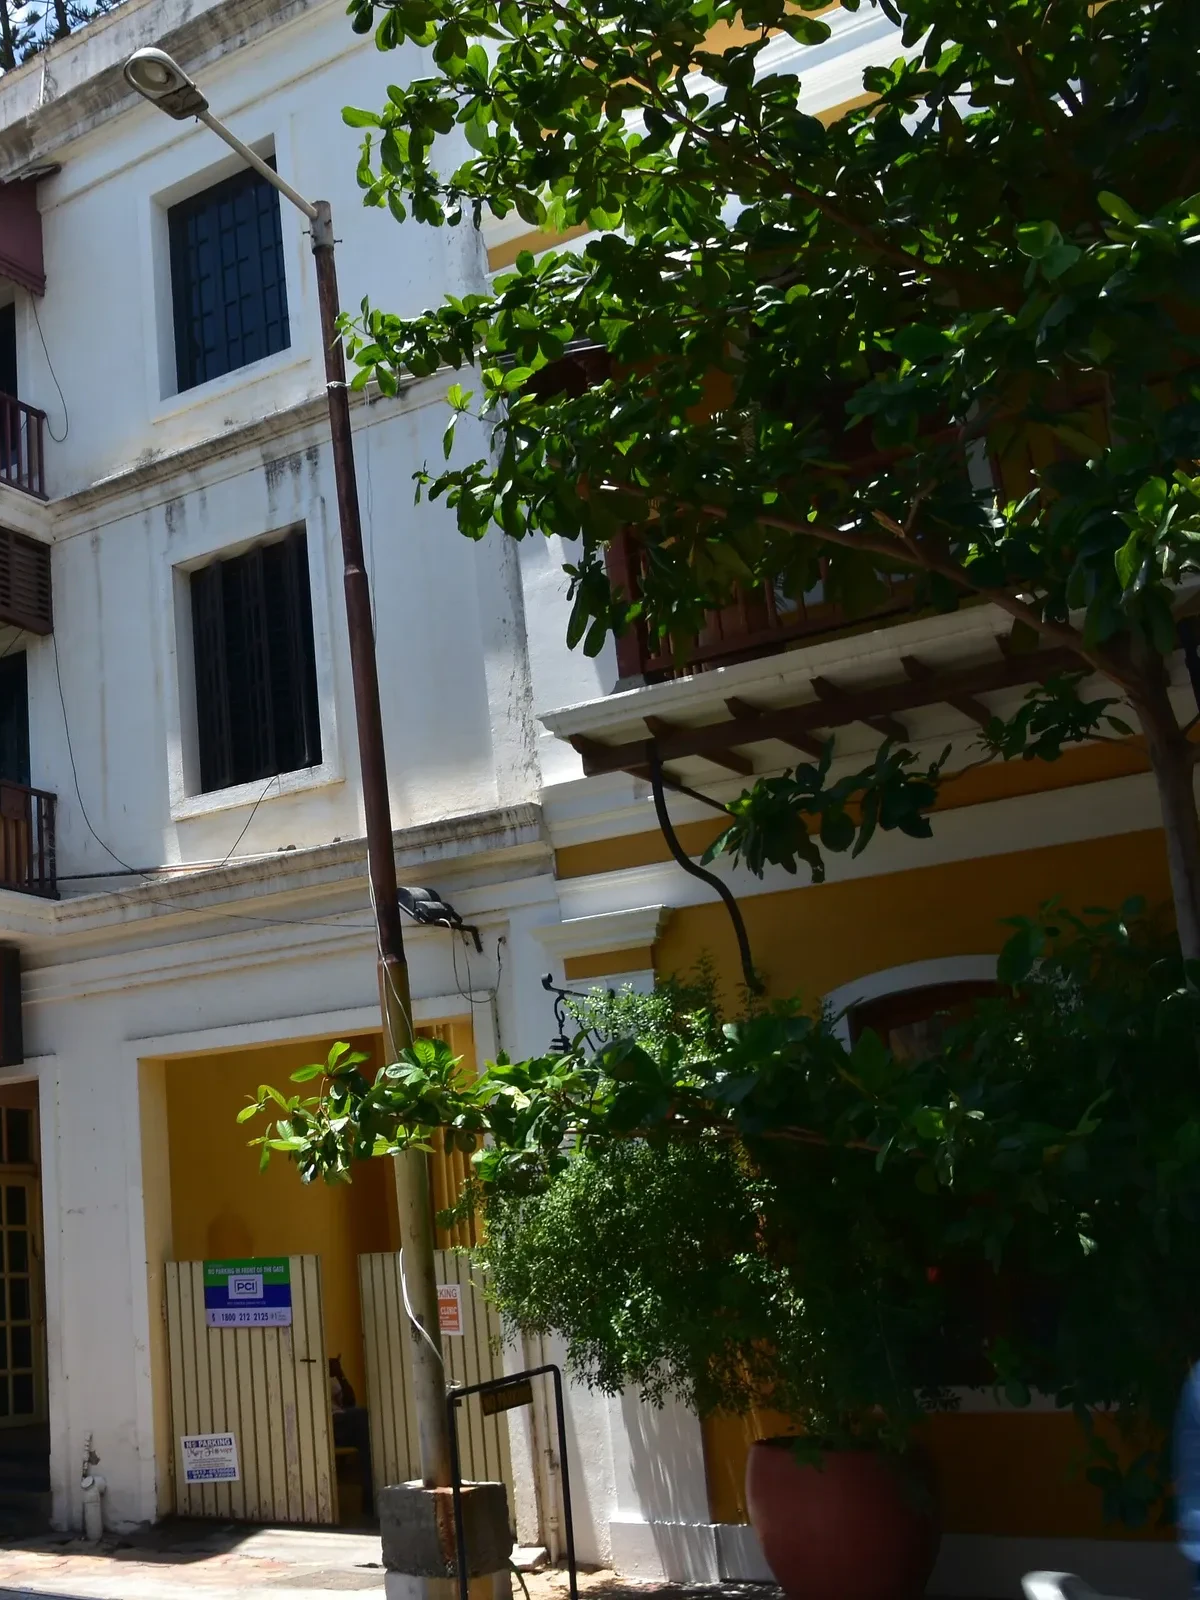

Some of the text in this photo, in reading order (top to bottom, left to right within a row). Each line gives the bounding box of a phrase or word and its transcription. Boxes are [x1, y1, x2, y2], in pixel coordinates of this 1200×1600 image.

[215, 1267, 235, 1275] PARKING
[272, 1265, 284, 1273] GATE
[236, 1282, 255, 1291] PCI
[438, 1288, 458, 1298] KING
[221, 1313, 236, 1322] 1800
[239, 1313, 250, 1321] 212
[253, 1312, 269, 1321] 2125
[199, 1438, 231, 1448] PARKING
